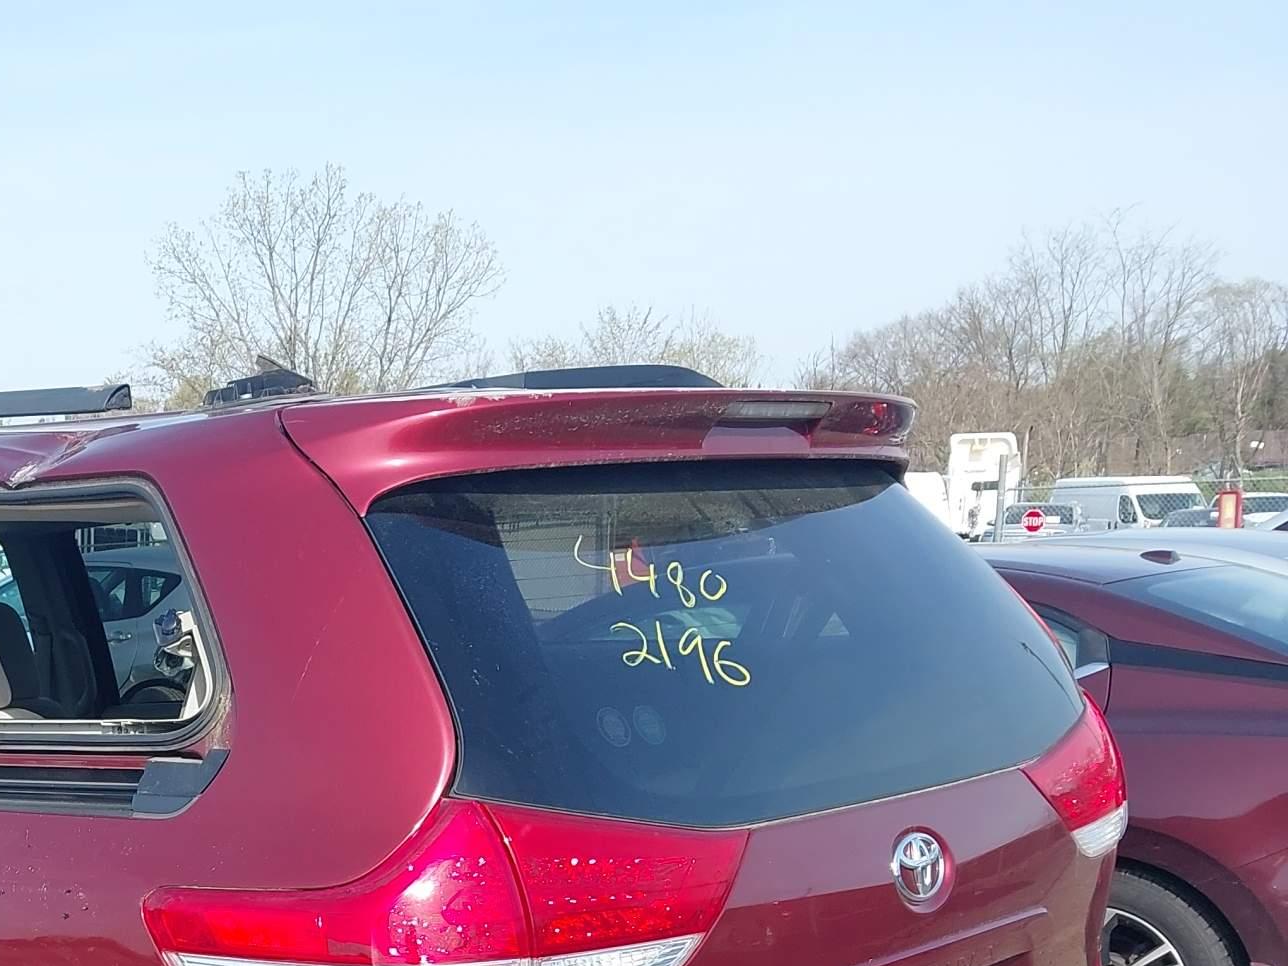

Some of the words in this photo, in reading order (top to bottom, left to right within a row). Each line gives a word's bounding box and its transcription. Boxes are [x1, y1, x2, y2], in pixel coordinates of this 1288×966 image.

[1023, 517, 1045, 527] STOP
[573, 534, 728, 609] 4480
[609, 620, 752, 687] 2196
